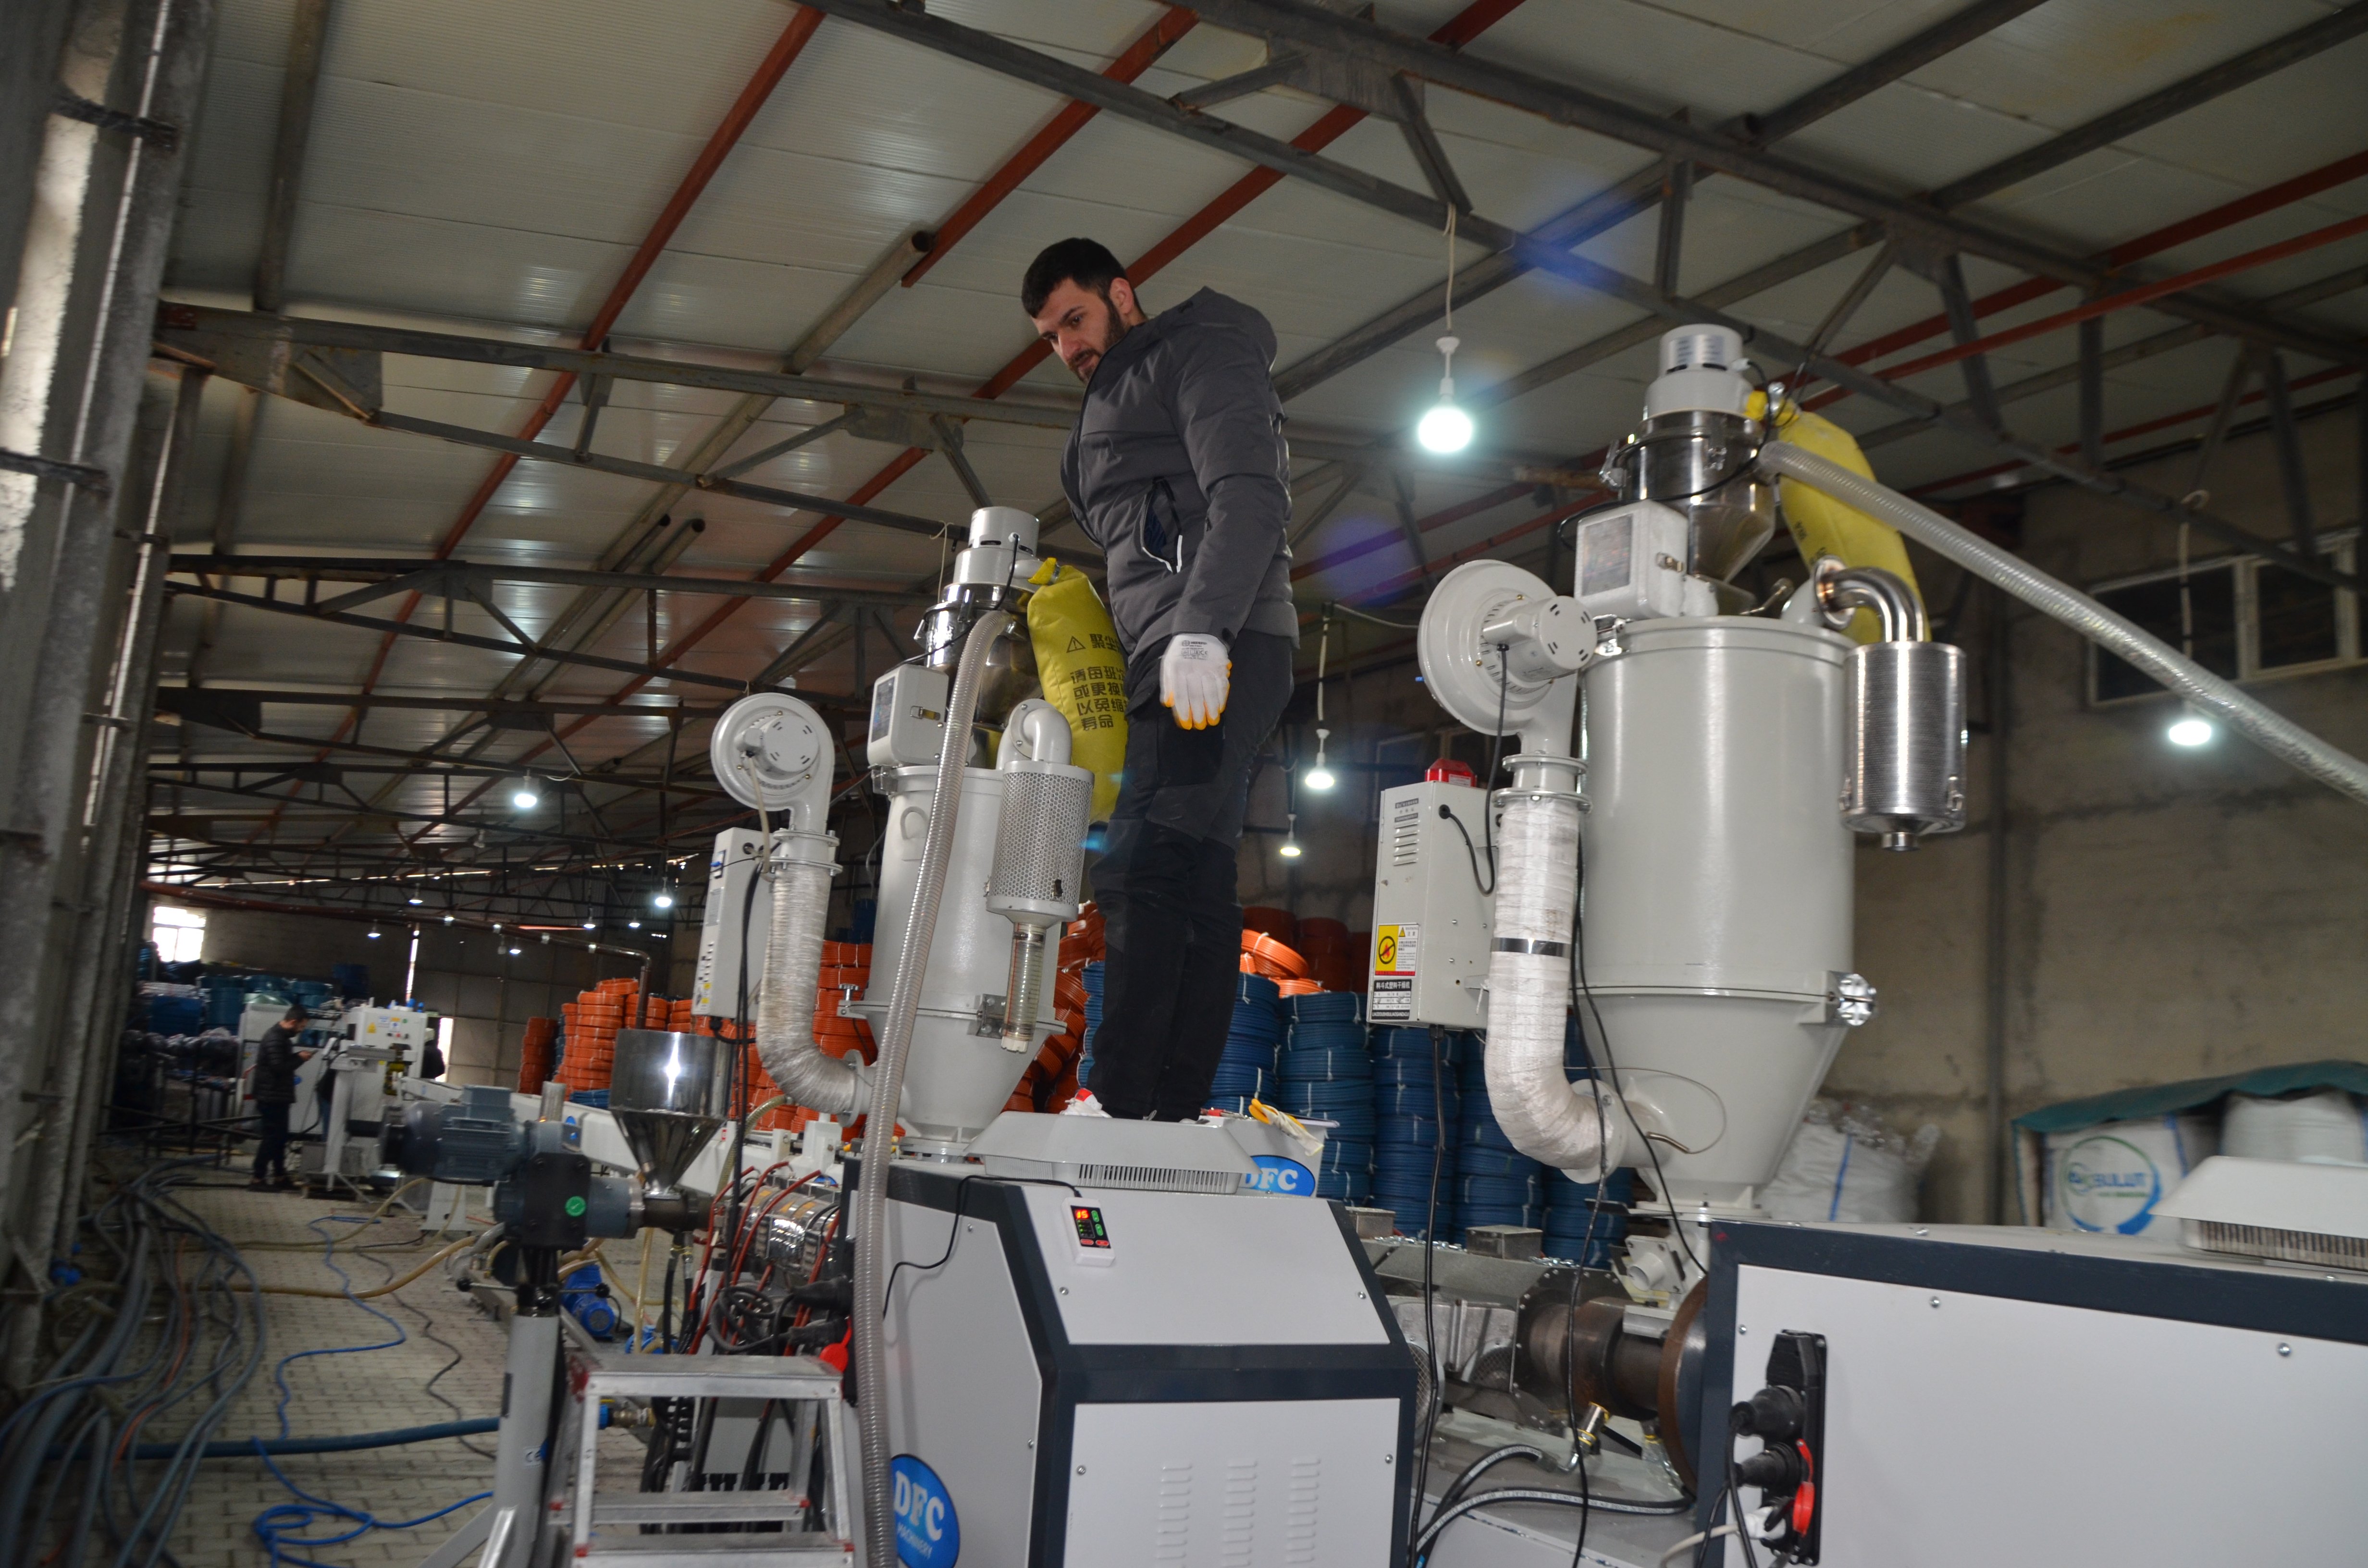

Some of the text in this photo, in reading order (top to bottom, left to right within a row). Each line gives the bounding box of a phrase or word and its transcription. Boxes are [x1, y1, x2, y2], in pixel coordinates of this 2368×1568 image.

[1089, 634, 1120, 652] 聚尘
[1073, 682, 1124, 699] 或更换
[1081, 714, 1114, 731] 寿命
[1239, 1168, 1298, 1191] DFC
[894, 1470, 945, 1541] DFC
